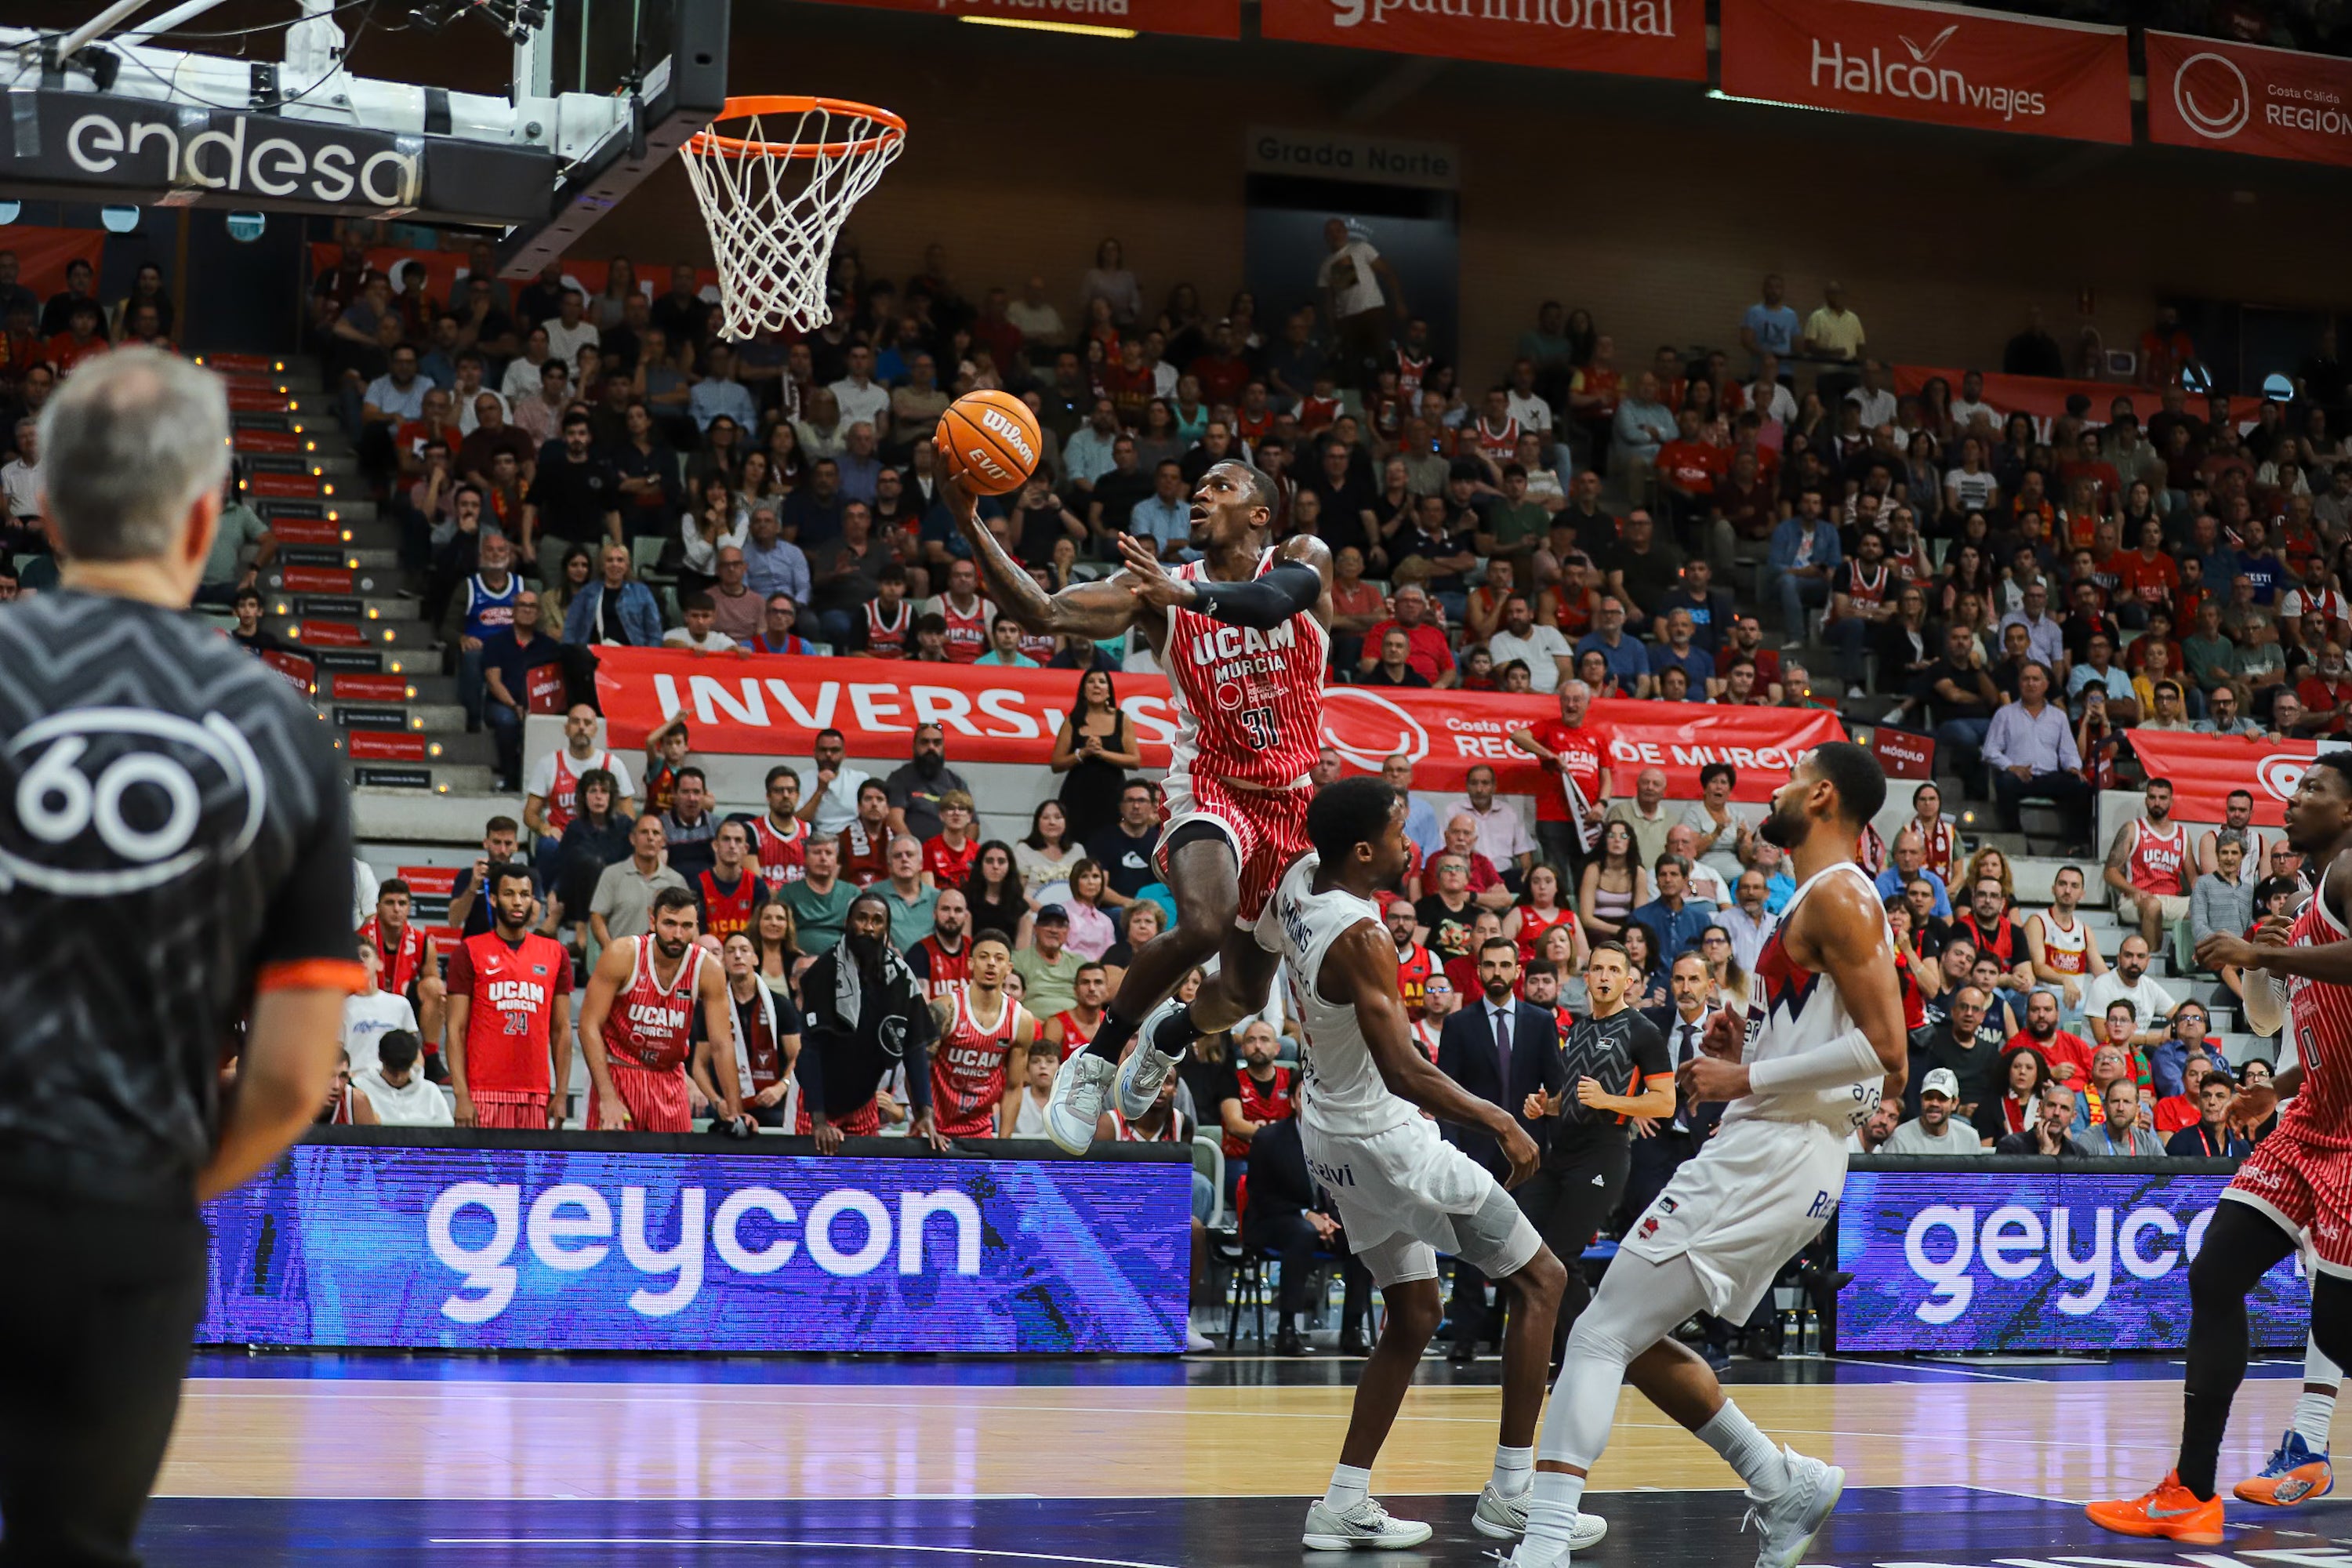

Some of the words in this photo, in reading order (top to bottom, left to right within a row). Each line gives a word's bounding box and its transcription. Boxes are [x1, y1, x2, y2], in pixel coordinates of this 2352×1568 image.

[2267, 84, 2301, 100] Costa
[2303, 89, 2340, 104] Cálida
[67, 114, 418, 207] endesa
[1257, 136, 1354, 169] Grada
[1368, 146, 1450, 177] Norte
[982, 408, 1035, 466] Wilson
[1192, 619, 1296, 666] UCAM
[1215, 655, 1287, 684] MURCIA
[1241, 706, 1279, 750] 31
[1446, 717, 1501, 734] Costa
[1454, 735, 1539, 760] REG
[1609, 739, 1667, 765] DE
[1880, 745, 1925, 763] MÓDULO
[16, 736, 201, 862] 60
[2143, 848, 2180, 869] UCAM
[489, 981, 544, 1004] UCAM
[496, 1000, 537, 1013] MURCIA
[628, 1004, 685, 1029] UCAM
[503, 1011, 528, 1035] 24
[633, 1024, 673, 1038] MURCIA
[948, 1047, 1003, 1069] UCAM
[428, 1181, 982, 1323] geycon
[1905, 1205, 2219, 1325] geyc
